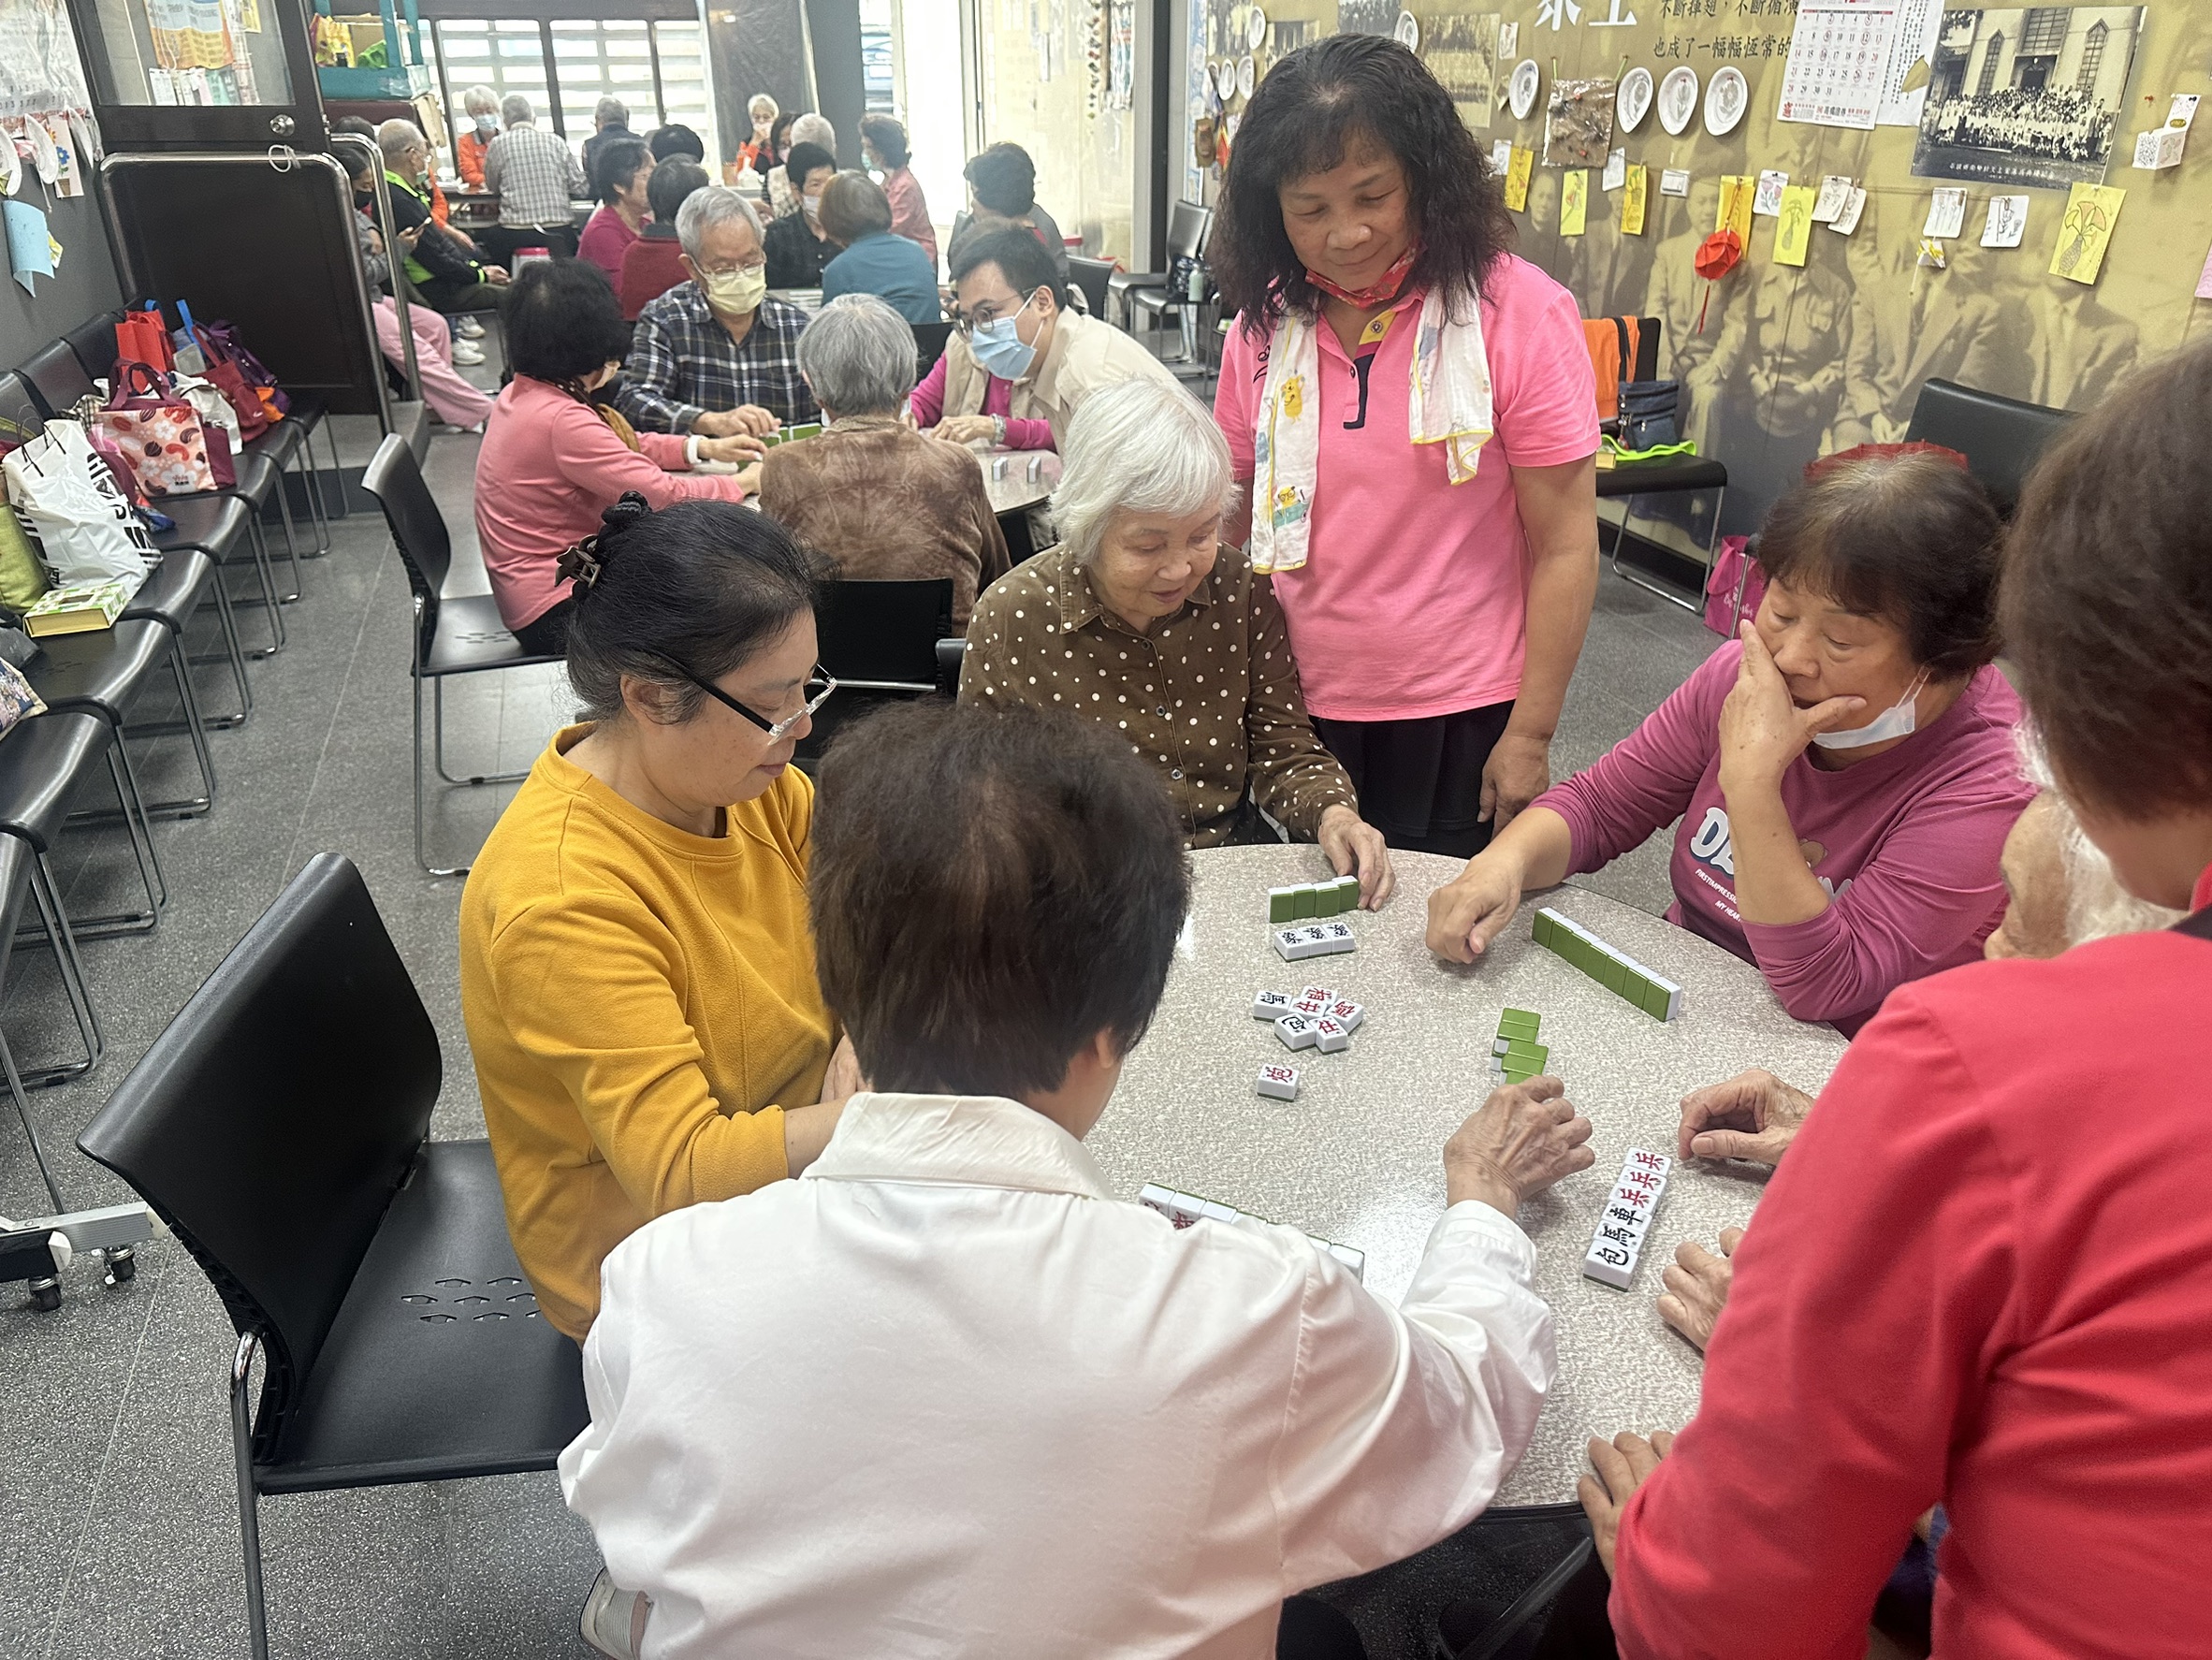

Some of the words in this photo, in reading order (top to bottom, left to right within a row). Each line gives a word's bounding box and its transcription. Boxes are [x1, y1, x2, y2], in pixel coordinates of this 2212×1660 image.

[1714, 900, 1727, 910] MY
[1260, 992, 1285, 1005] 馬
[1295, 1001, 1318, 1013] 仕
[1282, 1016, 1307, 1031] 包
[1318, 1020, 1338, 1035] 仕
[1636, 1152, 1664, 1171] 兵
[1630, 1172, 1661, 1190] 兵
[1620, 1188, 1650, 1208] 兵
[1609, 1207, 1644, 1225] 車
[1603, 1225, 1636, 1246] 馬
[1594, 1246, 1629, 1266] 包
